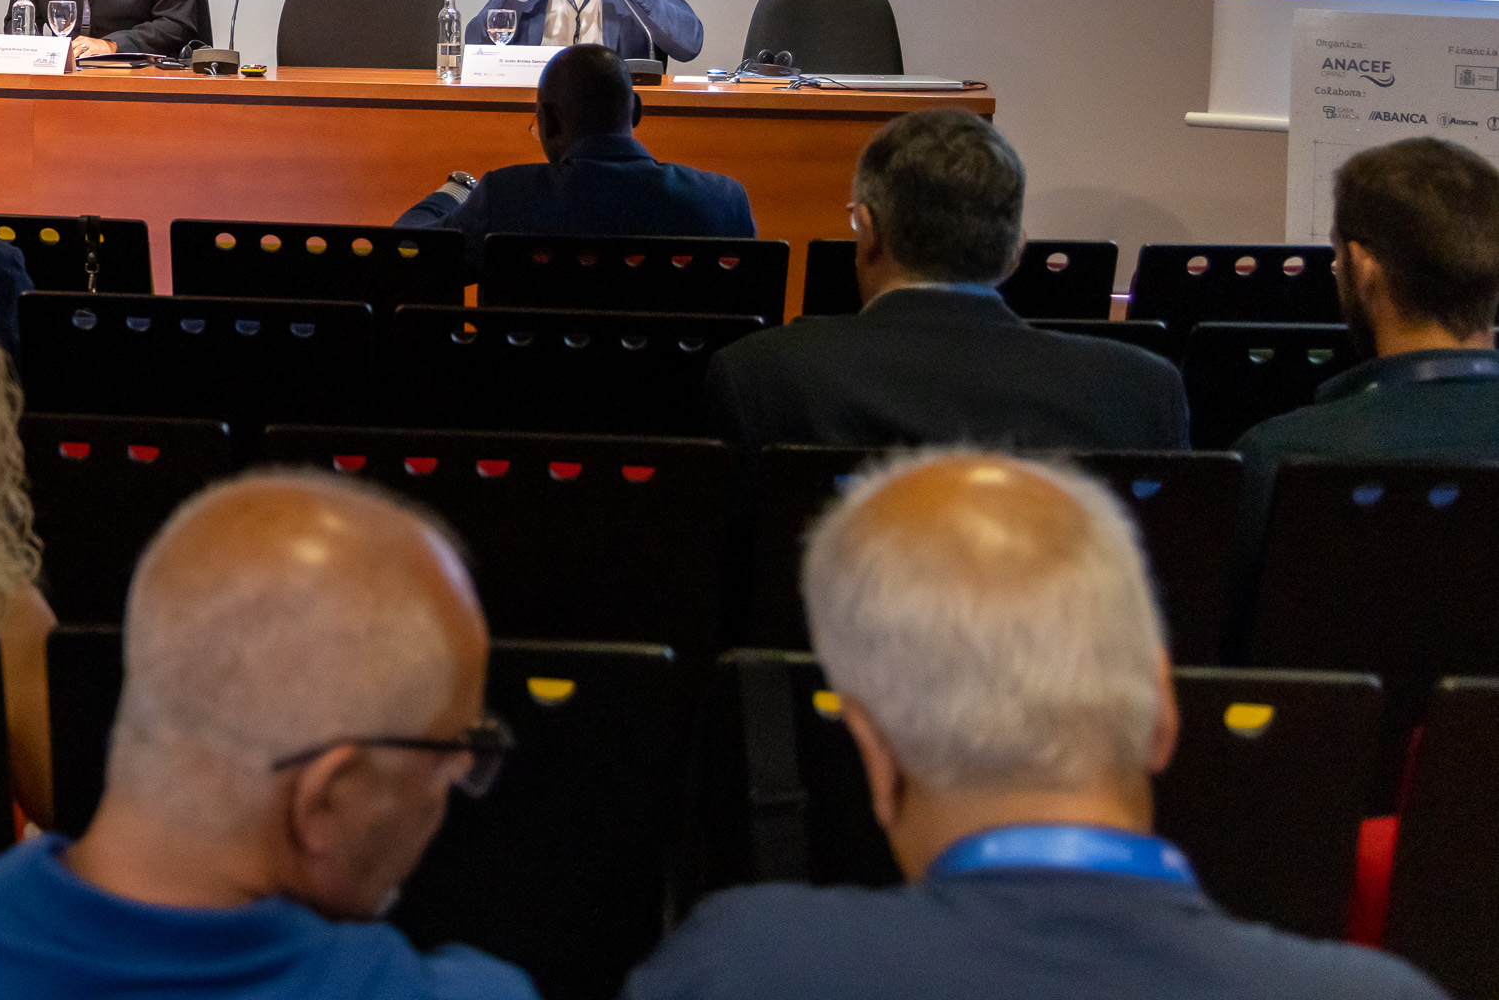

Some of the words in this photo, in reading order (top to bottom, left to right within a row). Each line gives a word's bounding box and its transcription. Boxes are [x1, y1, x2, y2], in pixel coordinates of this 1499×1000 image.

[1316, 39, 1367, 50] Organiza:
[1322, 58, 1392, 74] ANACEF
[1315, 86, 1365, 97] Colabora:
